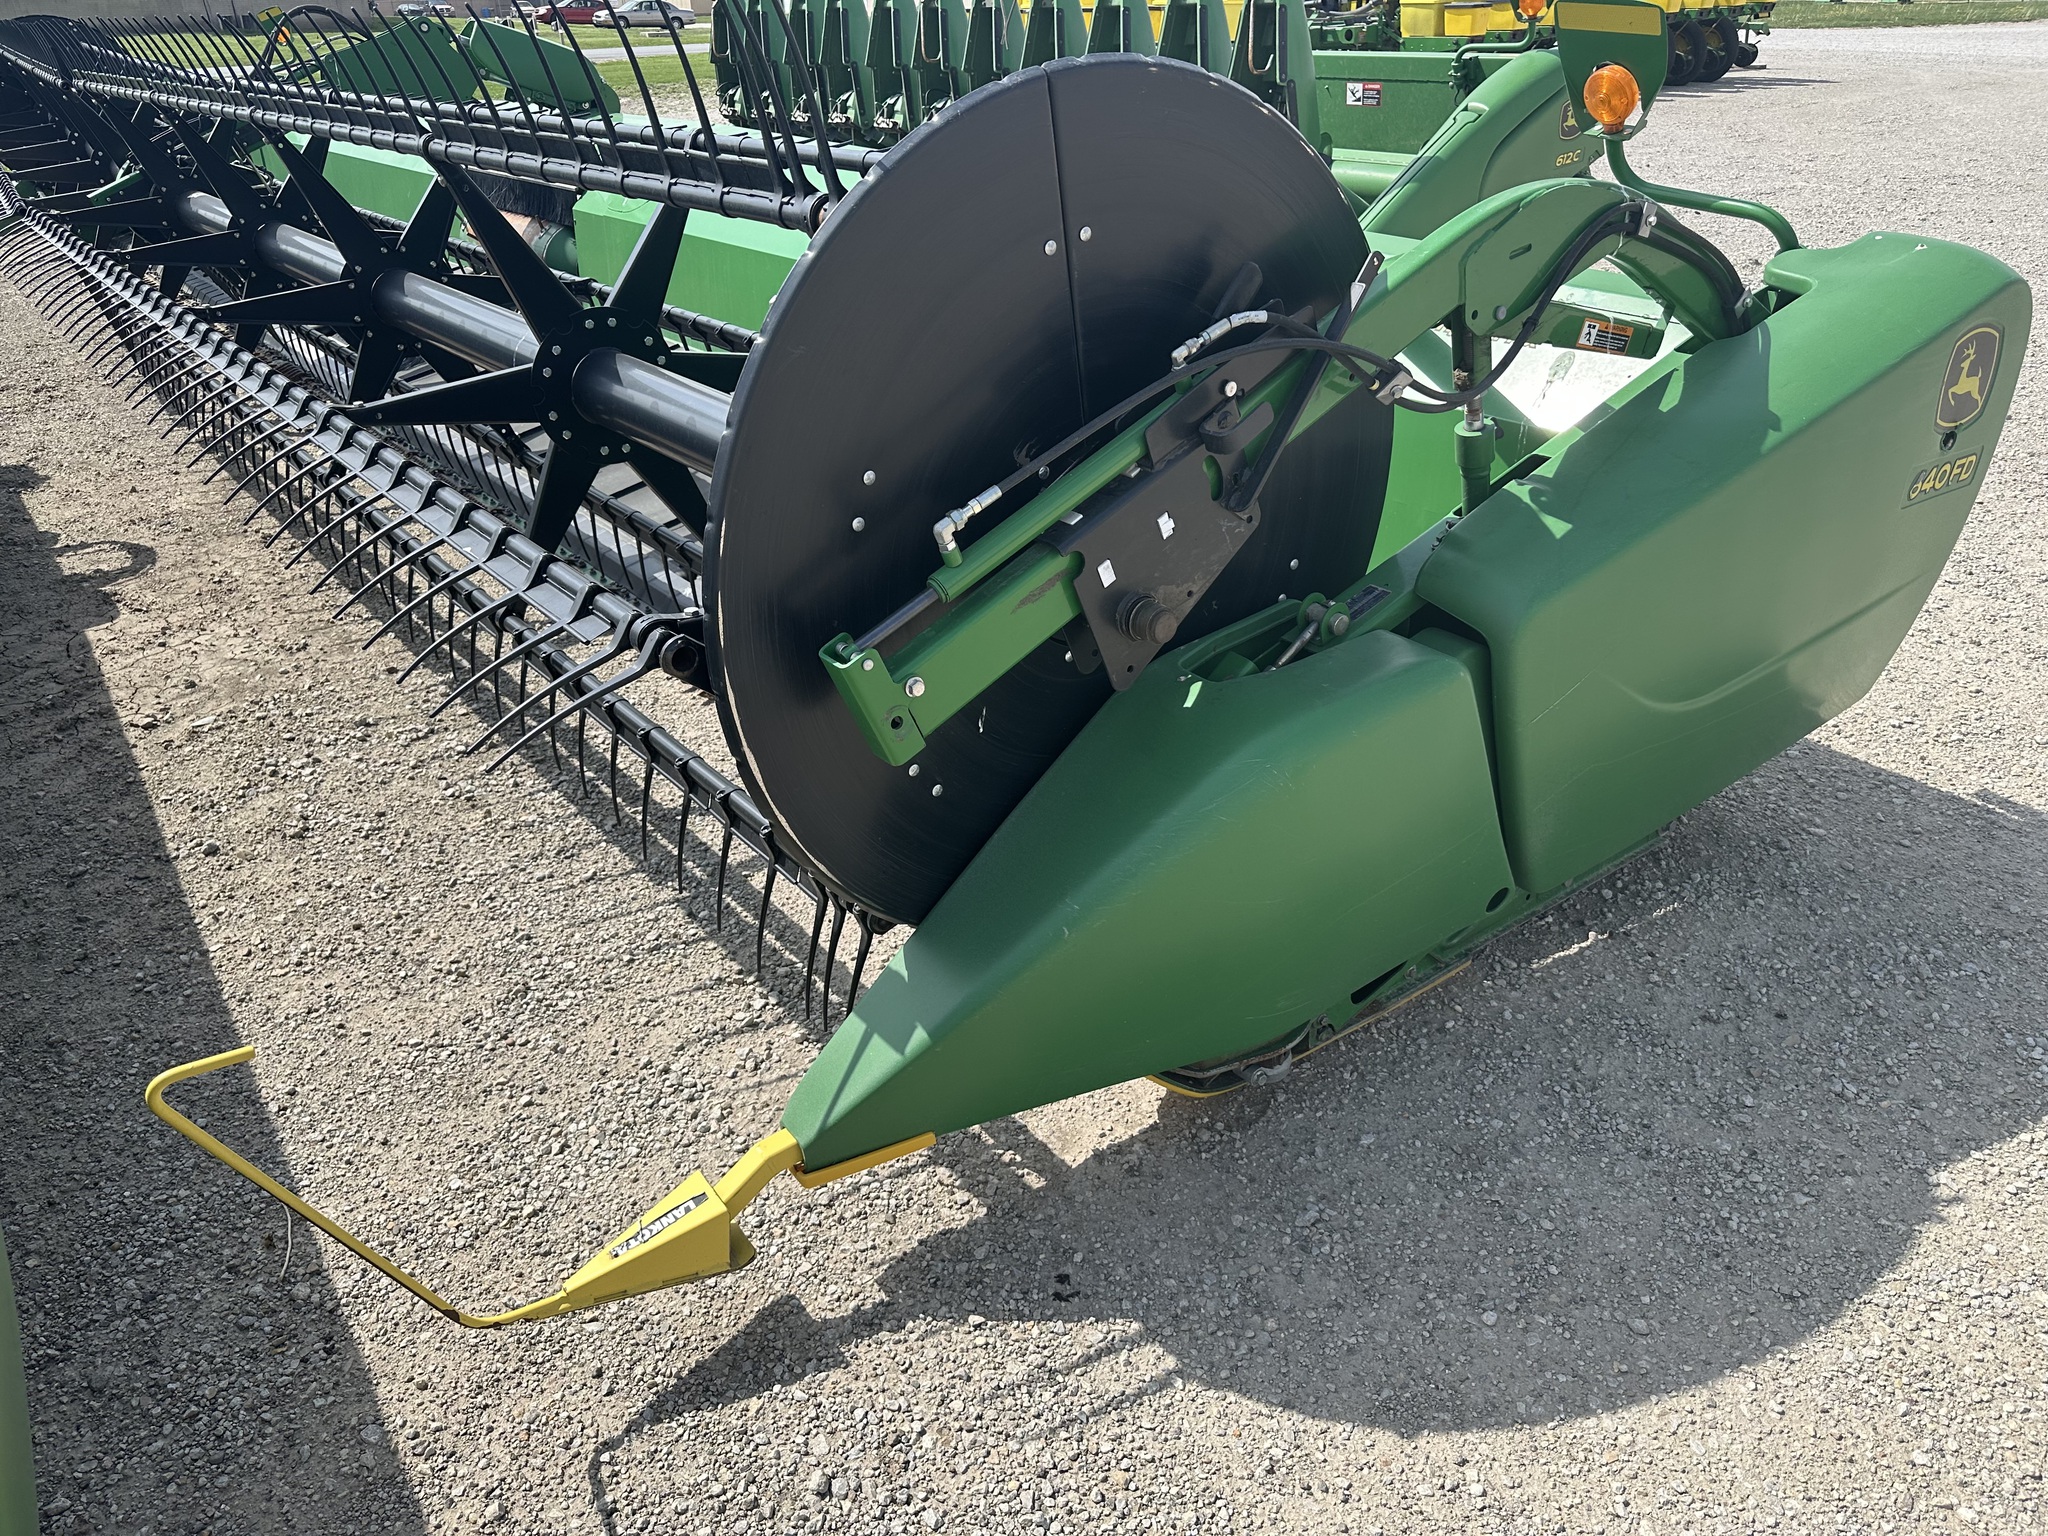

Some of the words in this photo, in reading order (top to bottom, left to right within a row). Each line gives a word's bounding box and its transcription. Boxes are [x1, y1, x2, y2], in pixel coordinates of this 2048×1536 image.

[1555, 149, 1581, 167] 612C
[1907, 453, 1977, 501] 640FD
[614, 1199, 697, 1258] LANKOTA
